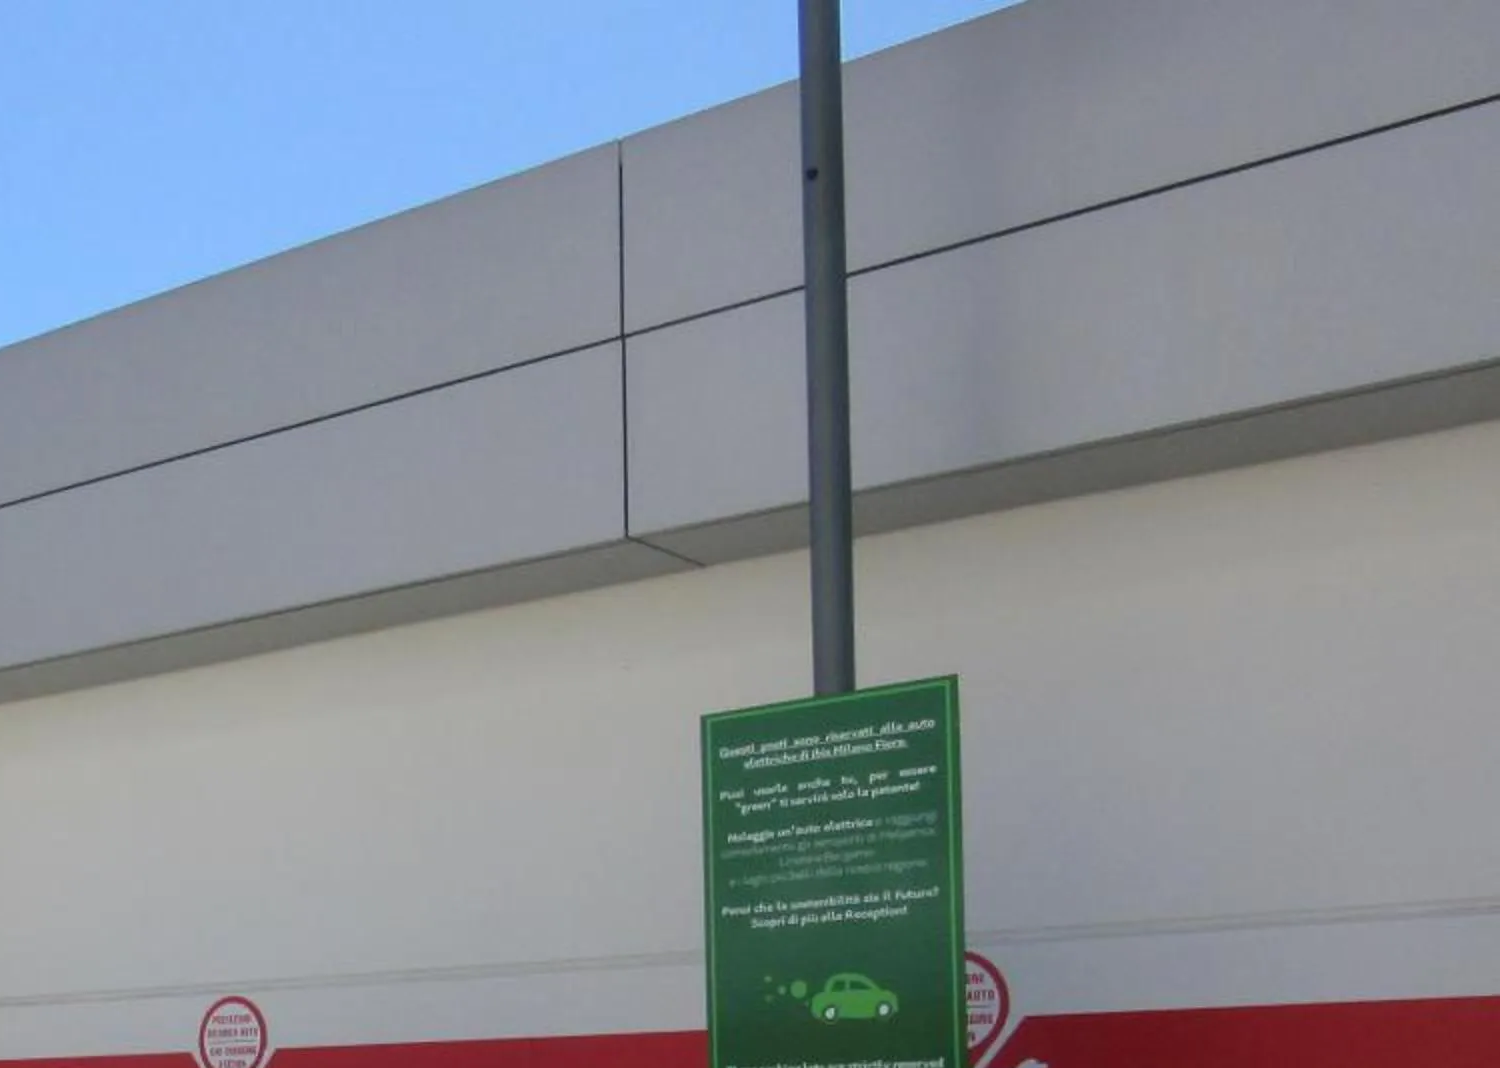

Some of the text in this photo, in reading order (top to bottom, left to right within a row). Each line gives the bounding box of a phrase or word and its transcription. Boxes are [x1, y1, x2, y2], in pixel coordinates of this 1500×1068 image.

[908, 719, 935, 731] auto
[869, 771, 889, 785] per
[858, 786, 869, 797] la
[753, 902, 774, 914] che
